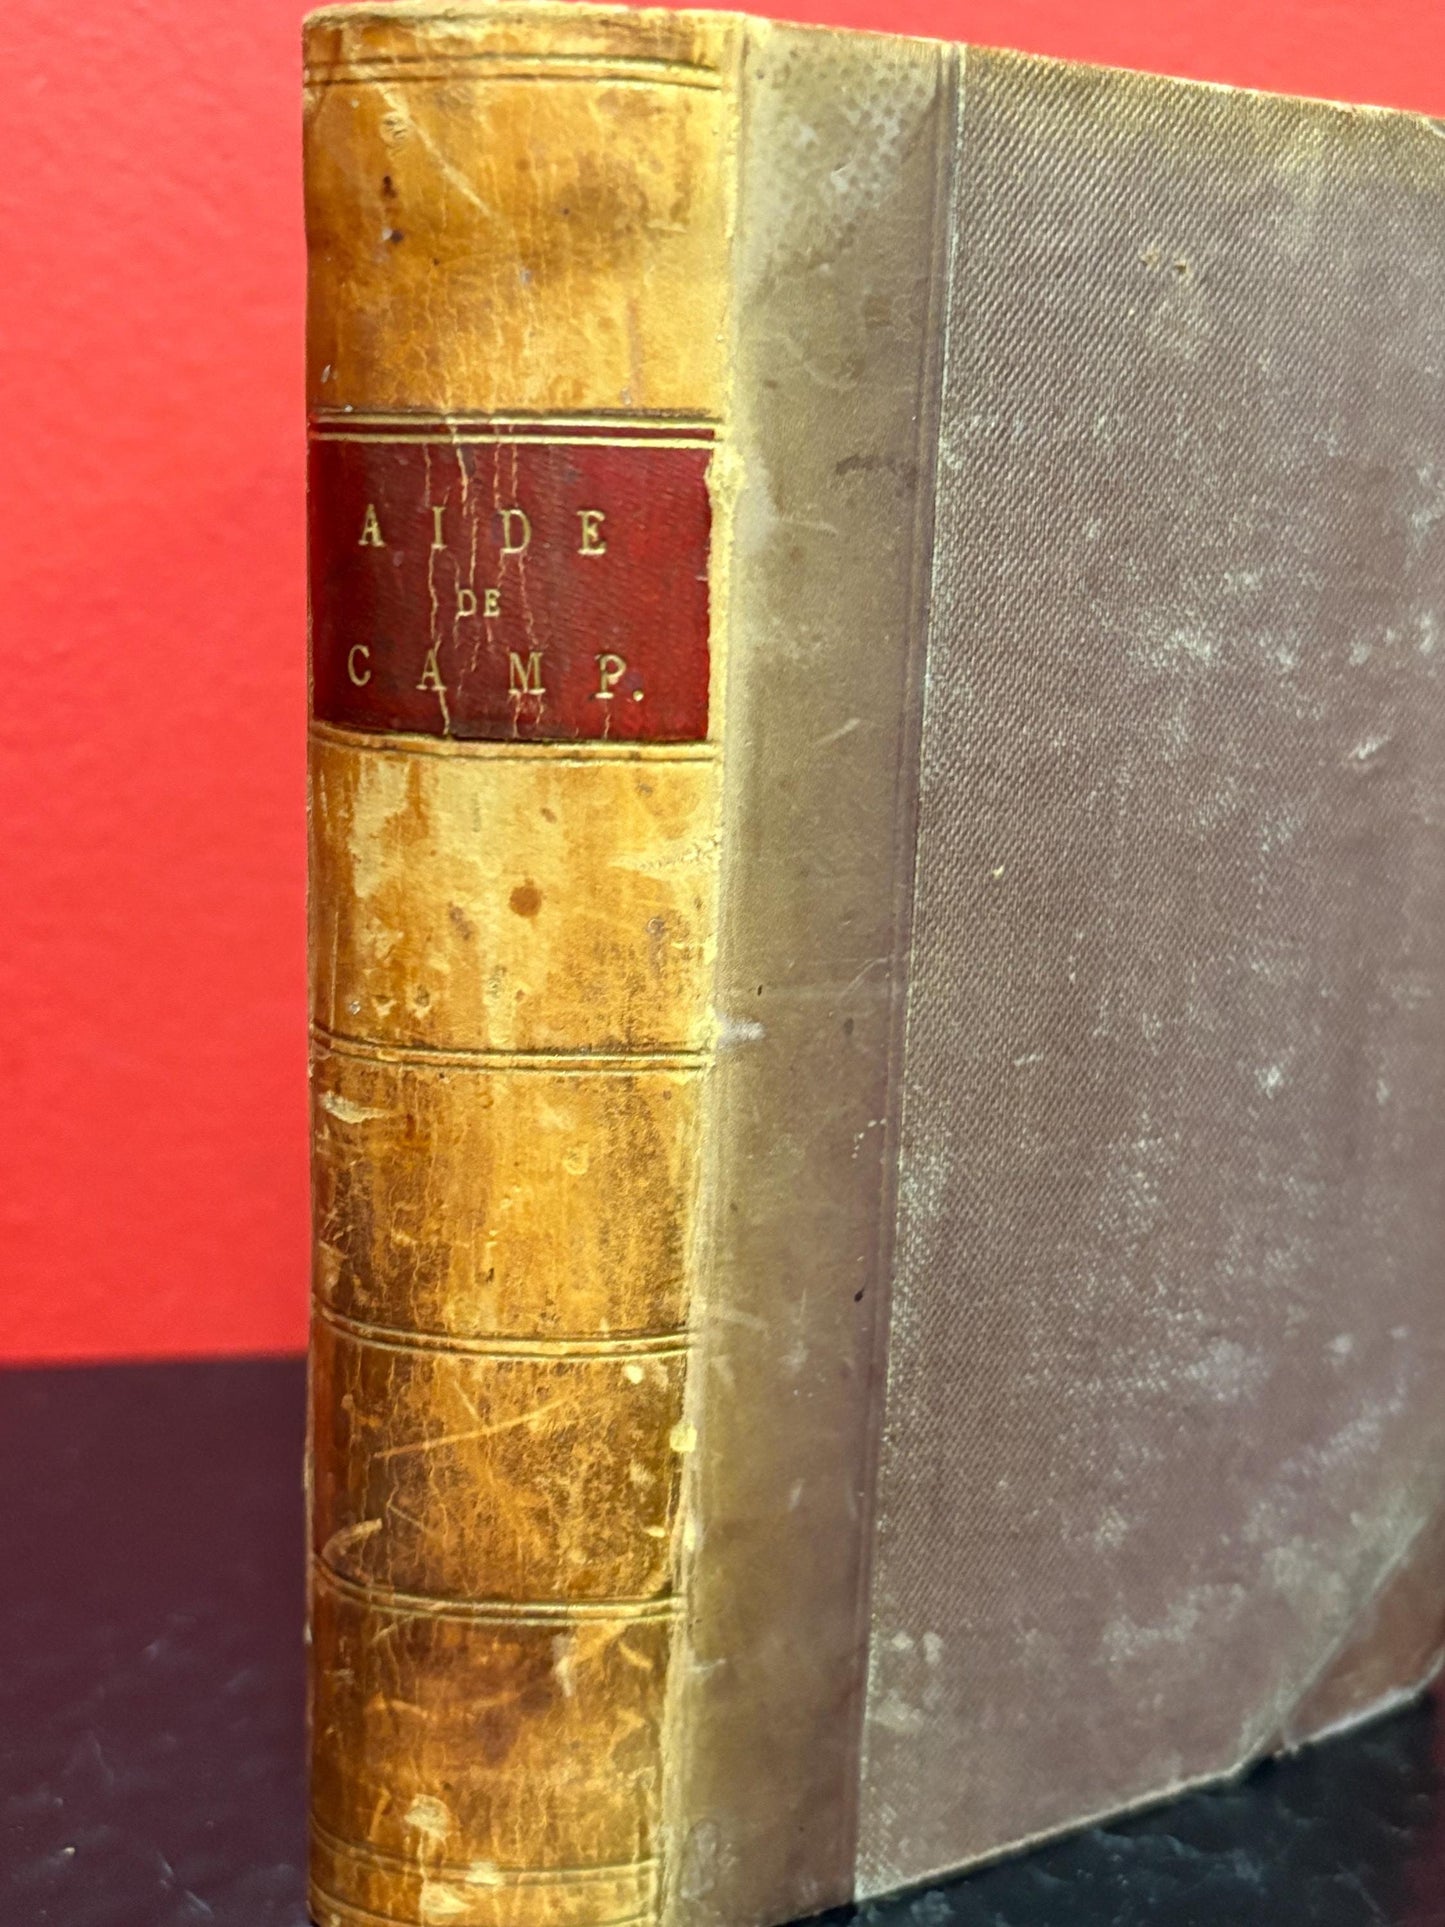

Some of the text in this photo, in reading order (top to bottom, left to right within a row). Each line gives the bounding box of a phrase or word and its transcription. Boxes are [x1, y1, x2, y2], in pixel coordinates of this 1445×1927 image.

[358, 504, 606, 555] AIDE
[456, 588, 501, 618] DE
[347, 645, 644, 701] CAMP.
